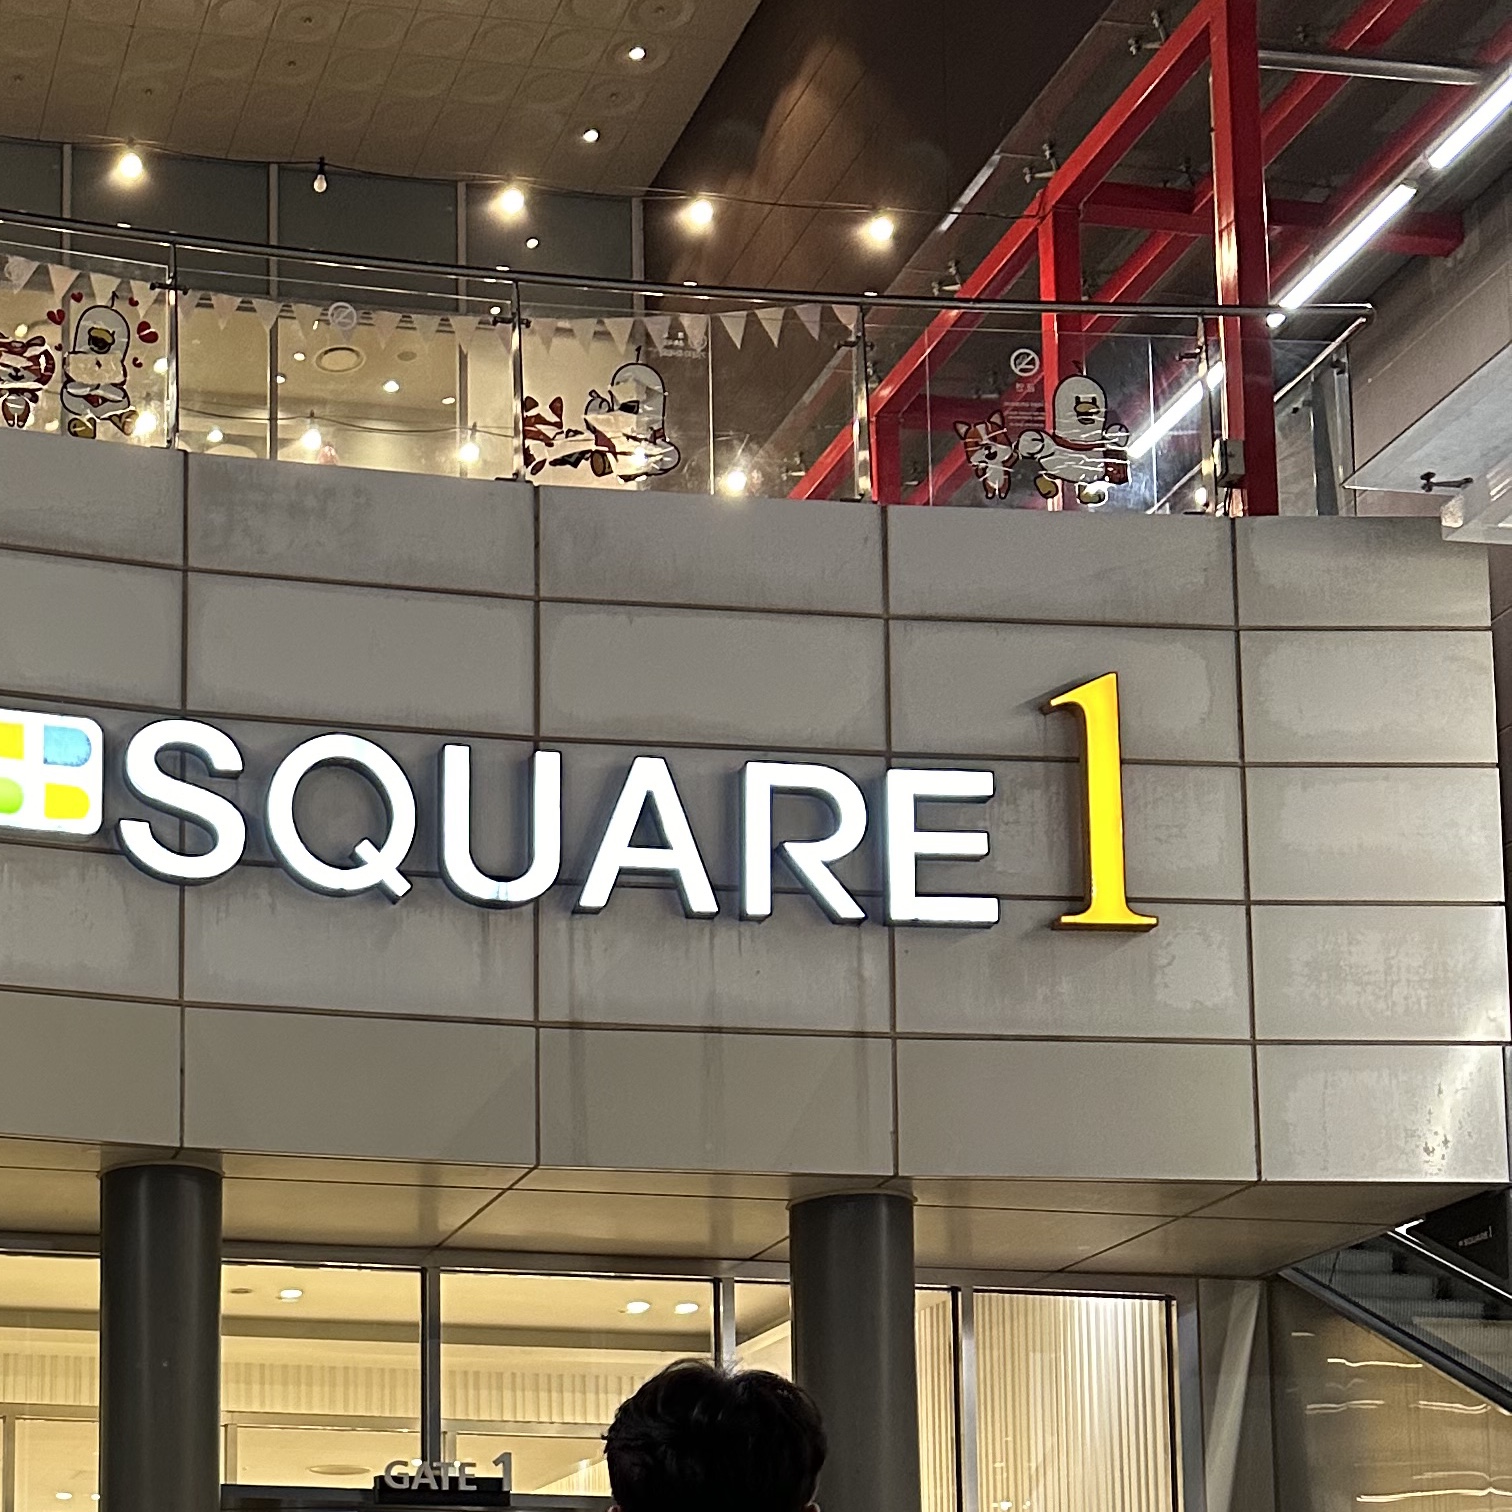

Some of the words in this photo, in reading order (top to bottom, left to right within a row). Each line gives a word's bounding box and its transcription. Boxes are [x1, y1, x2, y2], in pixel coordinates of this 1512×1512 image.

[116, 717, 1000, 928] SQUARE
[1042, 671, 1159, 932] 1
[384, 1460, 477, 1490] GATE
[492, 1452, 512, 1491] 1
